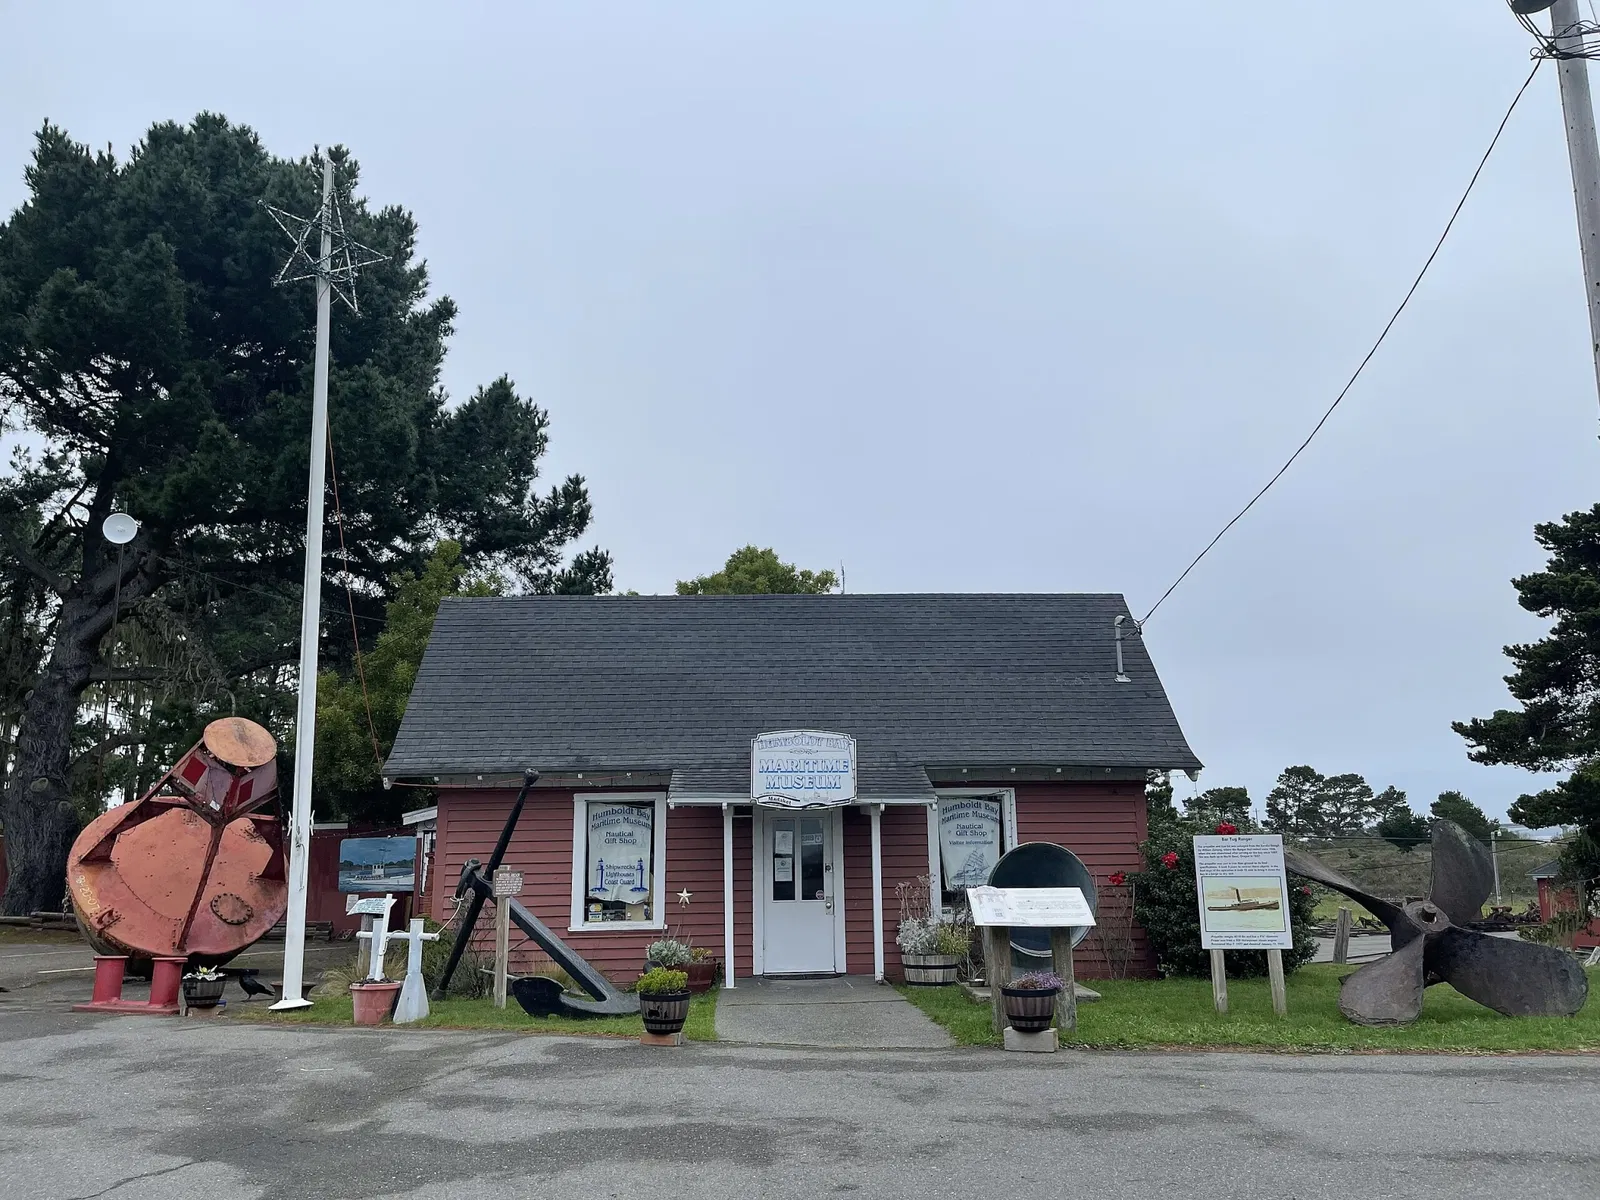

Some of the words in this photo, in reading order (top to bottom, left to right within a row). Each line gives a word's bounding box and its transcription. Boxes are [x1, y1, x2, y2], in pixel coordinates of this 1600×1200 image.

[758, 736, 822, 750] HUMBOLDT
[826, 737, 850, 750] BAY
[759, 759, 849, 773] MARITIME
[766, 775, 841, 789] MUSEUM
[592, 807, 634, 821] Humboldt
[637, 808, 651, 821] Bay
[942, 801, 982, 815] Humboldt
[985, 803, 998, 815] Bay
[591, 818, 621, 831] Maritime
[623, 817, 652, 830] Museum
[941, 811, 970, 825] Maritime
[972, 810, 1000, 824] Museum
